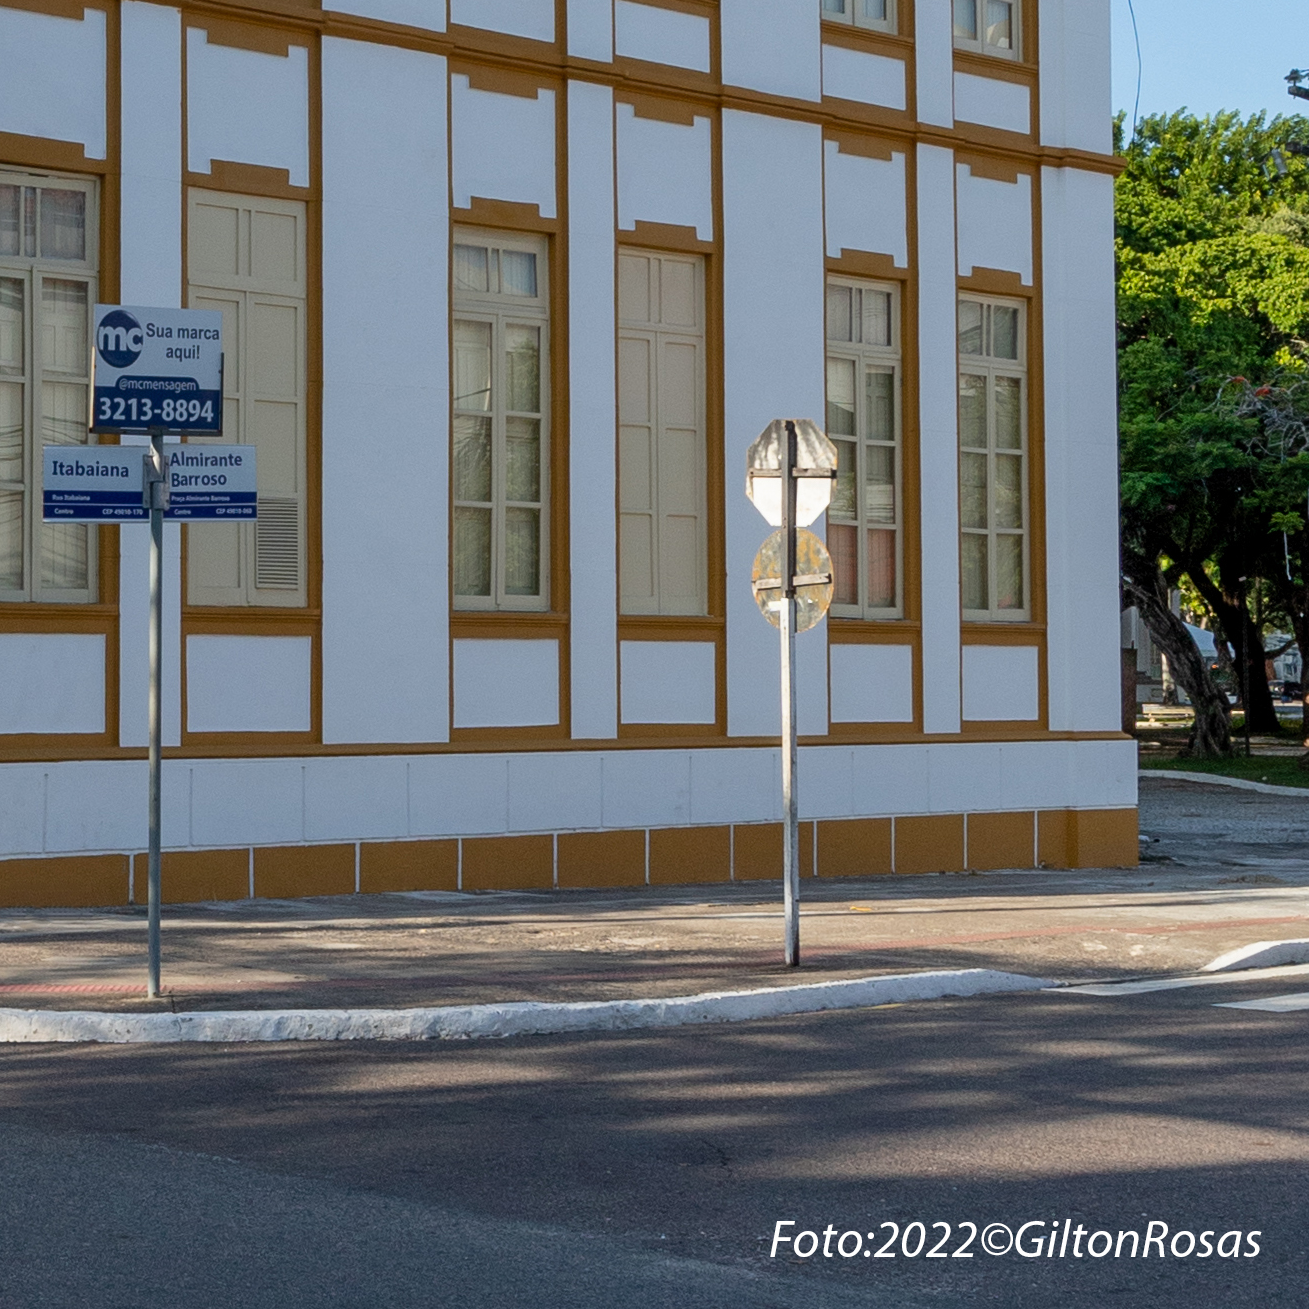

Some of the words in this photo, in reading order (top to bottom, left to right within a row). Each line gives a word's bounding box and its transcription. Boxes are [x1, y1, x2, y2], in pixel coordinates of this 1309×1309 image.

[98, 325, 143, 352] mc
[146, 322, 172, 339] Sua
[177, 325, 220, 341] marca
[166, 345, 200, 362] aqui!
[119, 378, 196, 393] @mcmensagem
[99, 397, 214, 422] 3213-8894
[170, 451, 243, 467] Almirante
[52, 460, 129, 478] Itabaiana
[171, 473, 227, 487] Barroso
[54, 507, 74, 515] Centro
